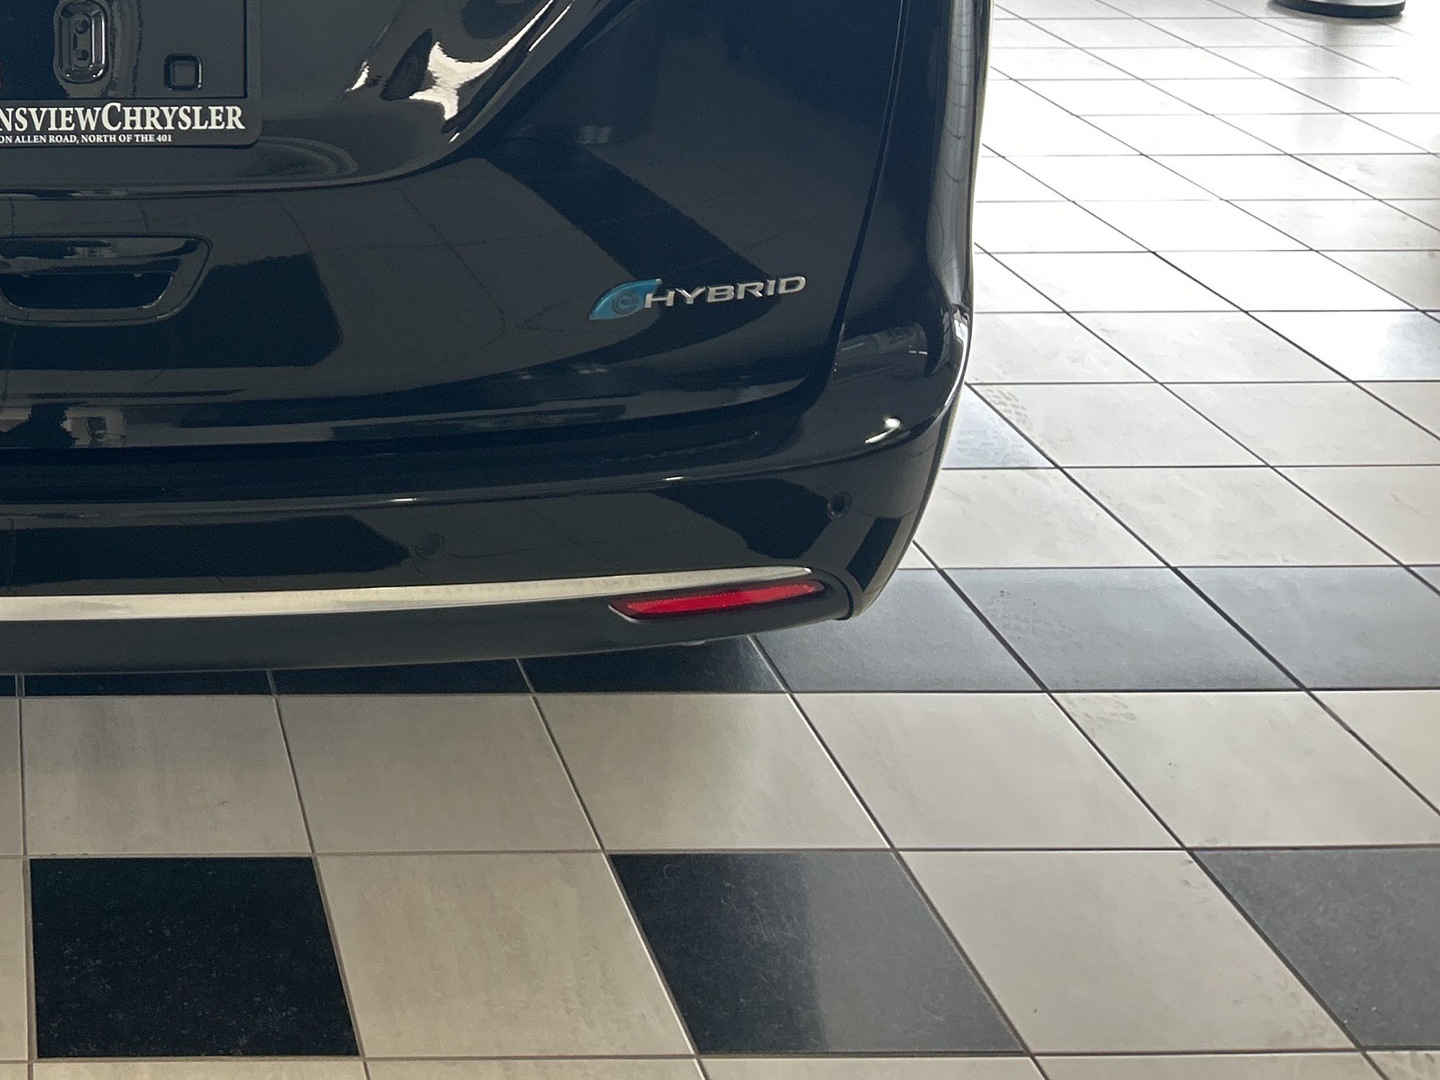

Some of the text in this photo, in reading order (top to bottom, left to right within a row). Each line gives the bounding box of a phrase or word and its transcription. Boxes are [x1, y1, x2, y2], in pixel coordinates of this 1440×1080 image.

[14, 134, 47, 144] ALLEN
[49, 134, 79, 145] ROAD,
[81, 134, 117, 144] NORTH
[119, 134, 133, 143] OF
[134, 134, 155, 143] THE
[156, 134, 172, 143] 401
[644, 275, 807, 309] HYBRID
